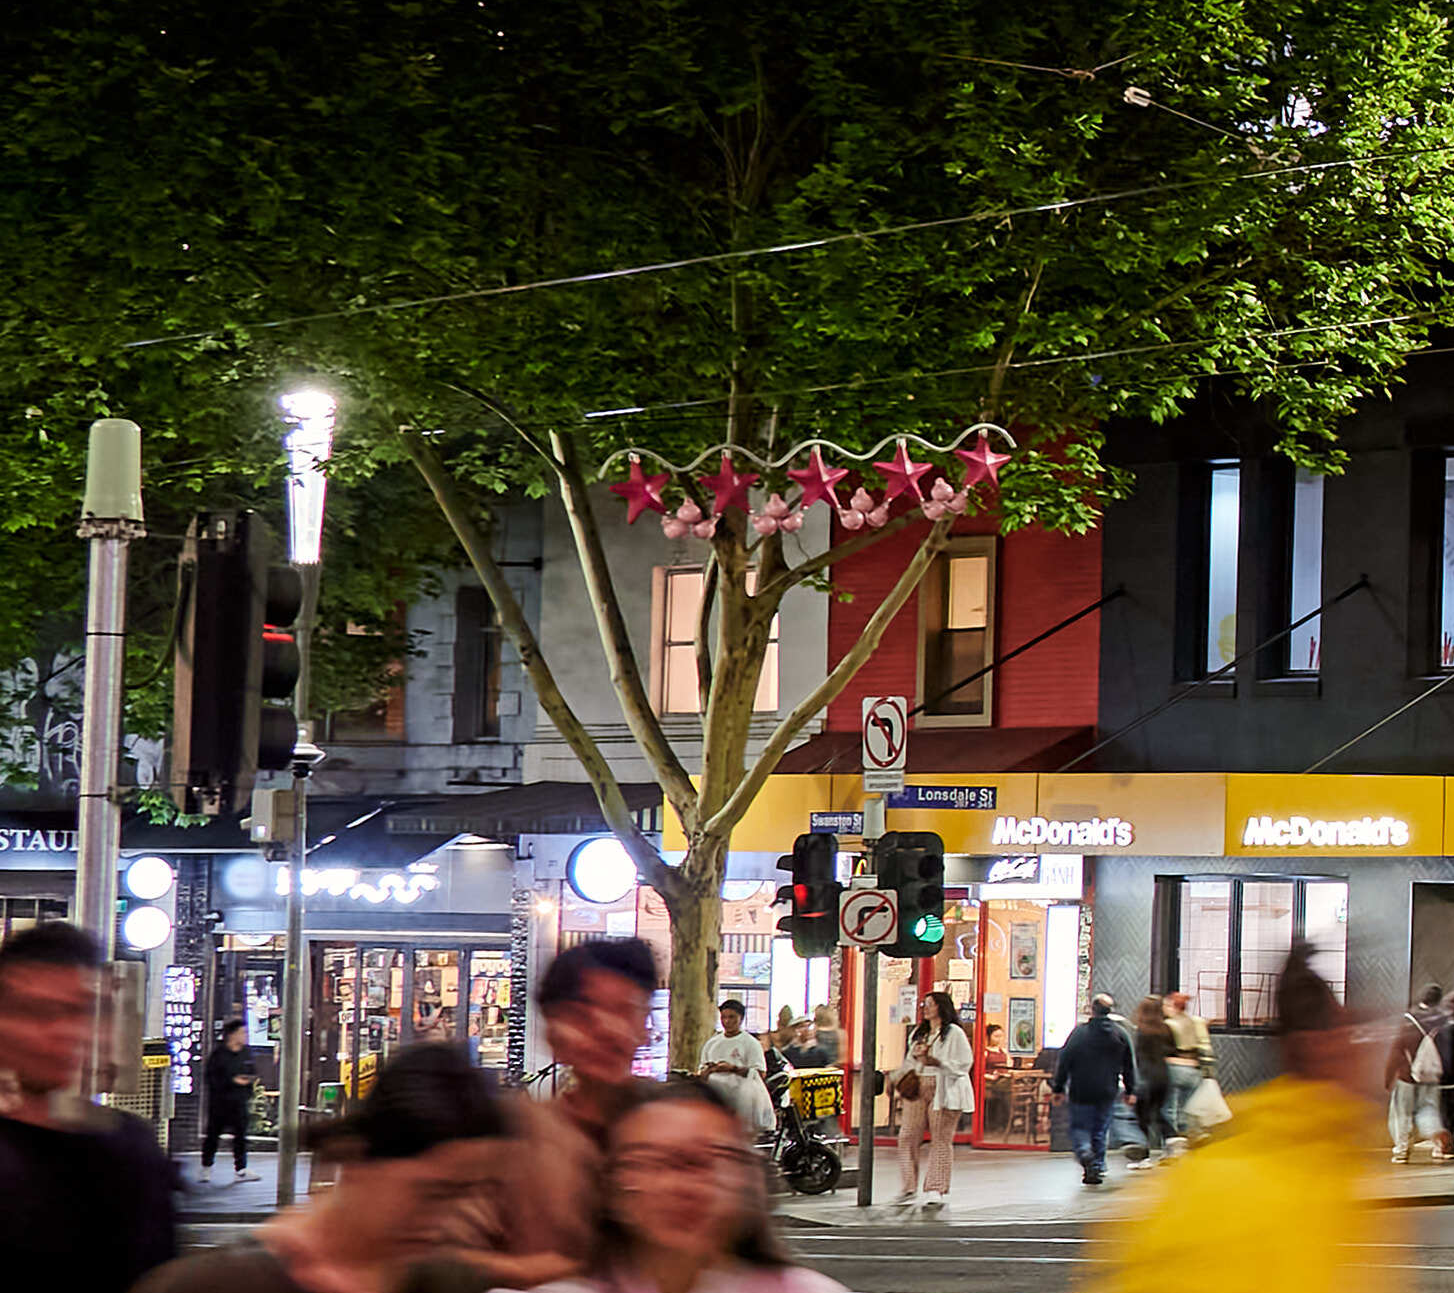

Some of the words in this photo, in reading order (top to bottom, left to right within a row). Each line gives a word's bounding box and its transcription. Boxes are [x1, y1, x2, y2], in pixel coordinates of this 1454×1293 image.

[917, 787, 977, 801] Lonsdale
[979, 788, 993, 802] St
[991, 816, 1134, 846] McDonald's
[1242, 815, 1409, 846] McDonald's
